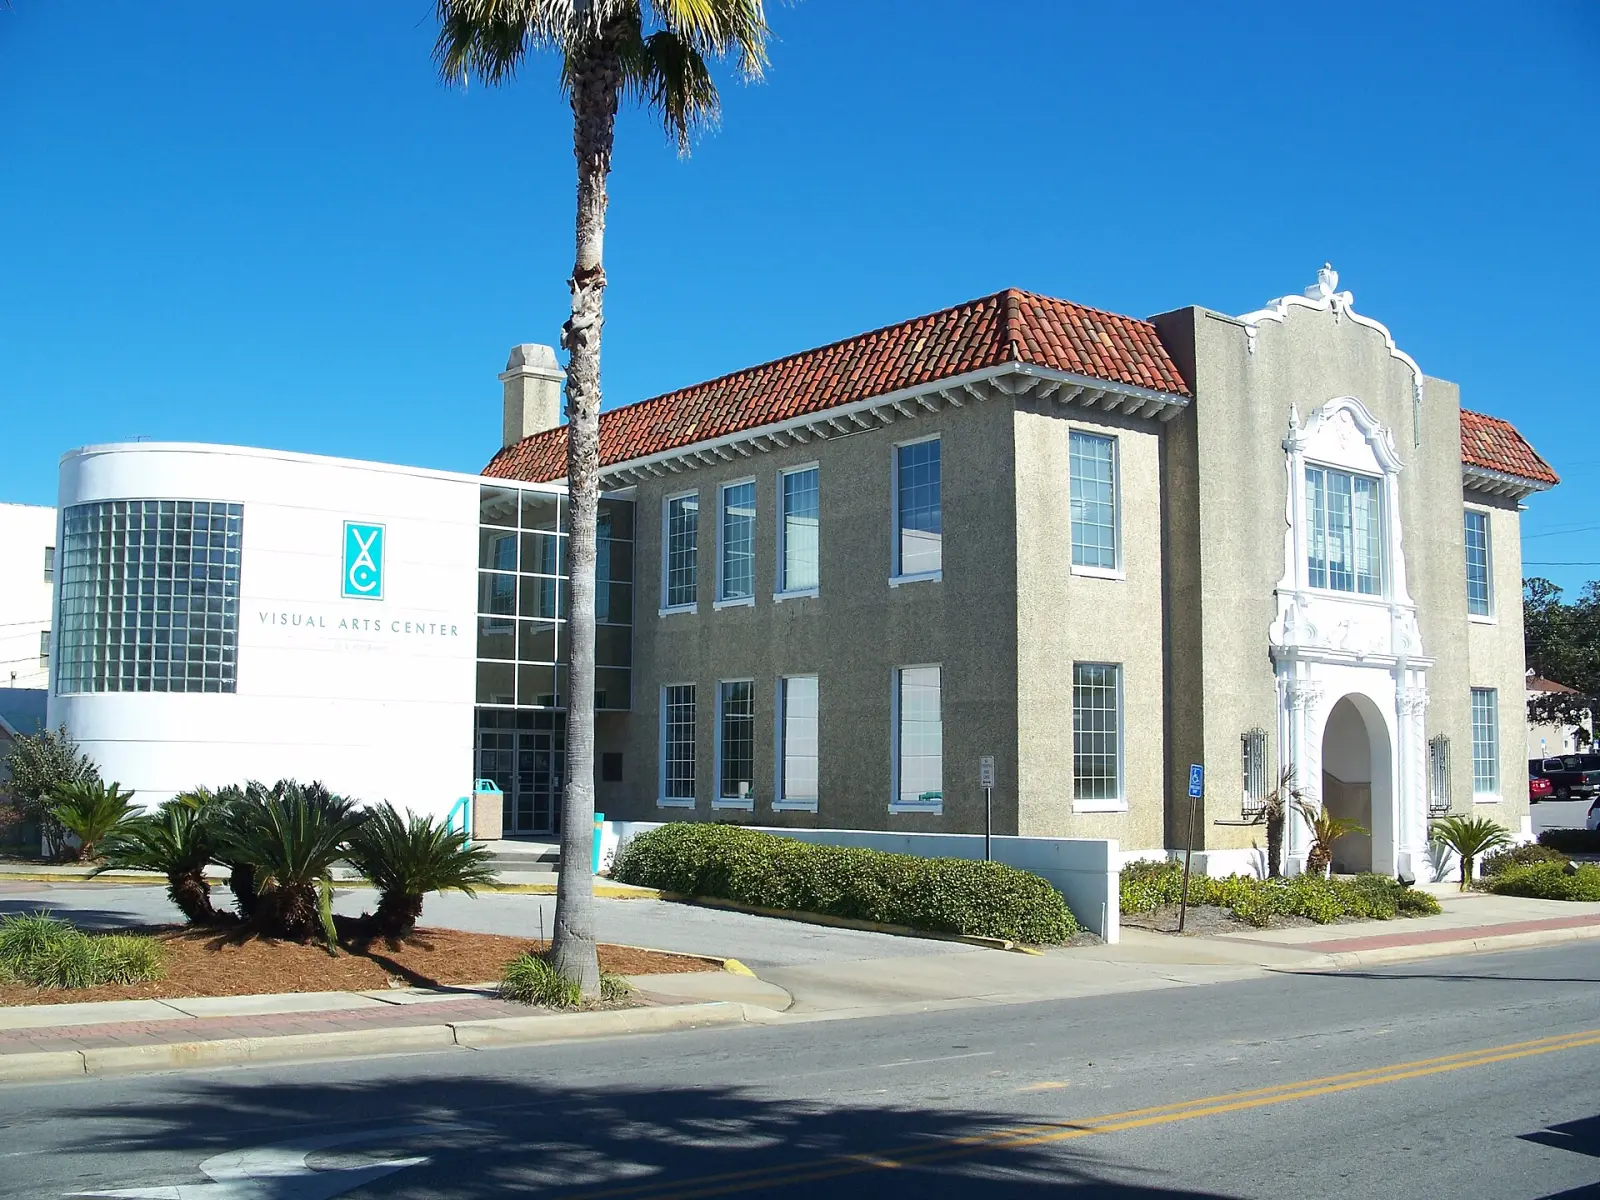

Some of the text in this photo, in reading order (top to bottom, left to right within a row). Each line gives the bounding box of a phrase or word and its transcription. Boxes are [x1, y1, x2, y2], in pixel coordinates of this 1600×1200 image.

[259, 611, 458, 636] VISUAL ARTS CENTER
